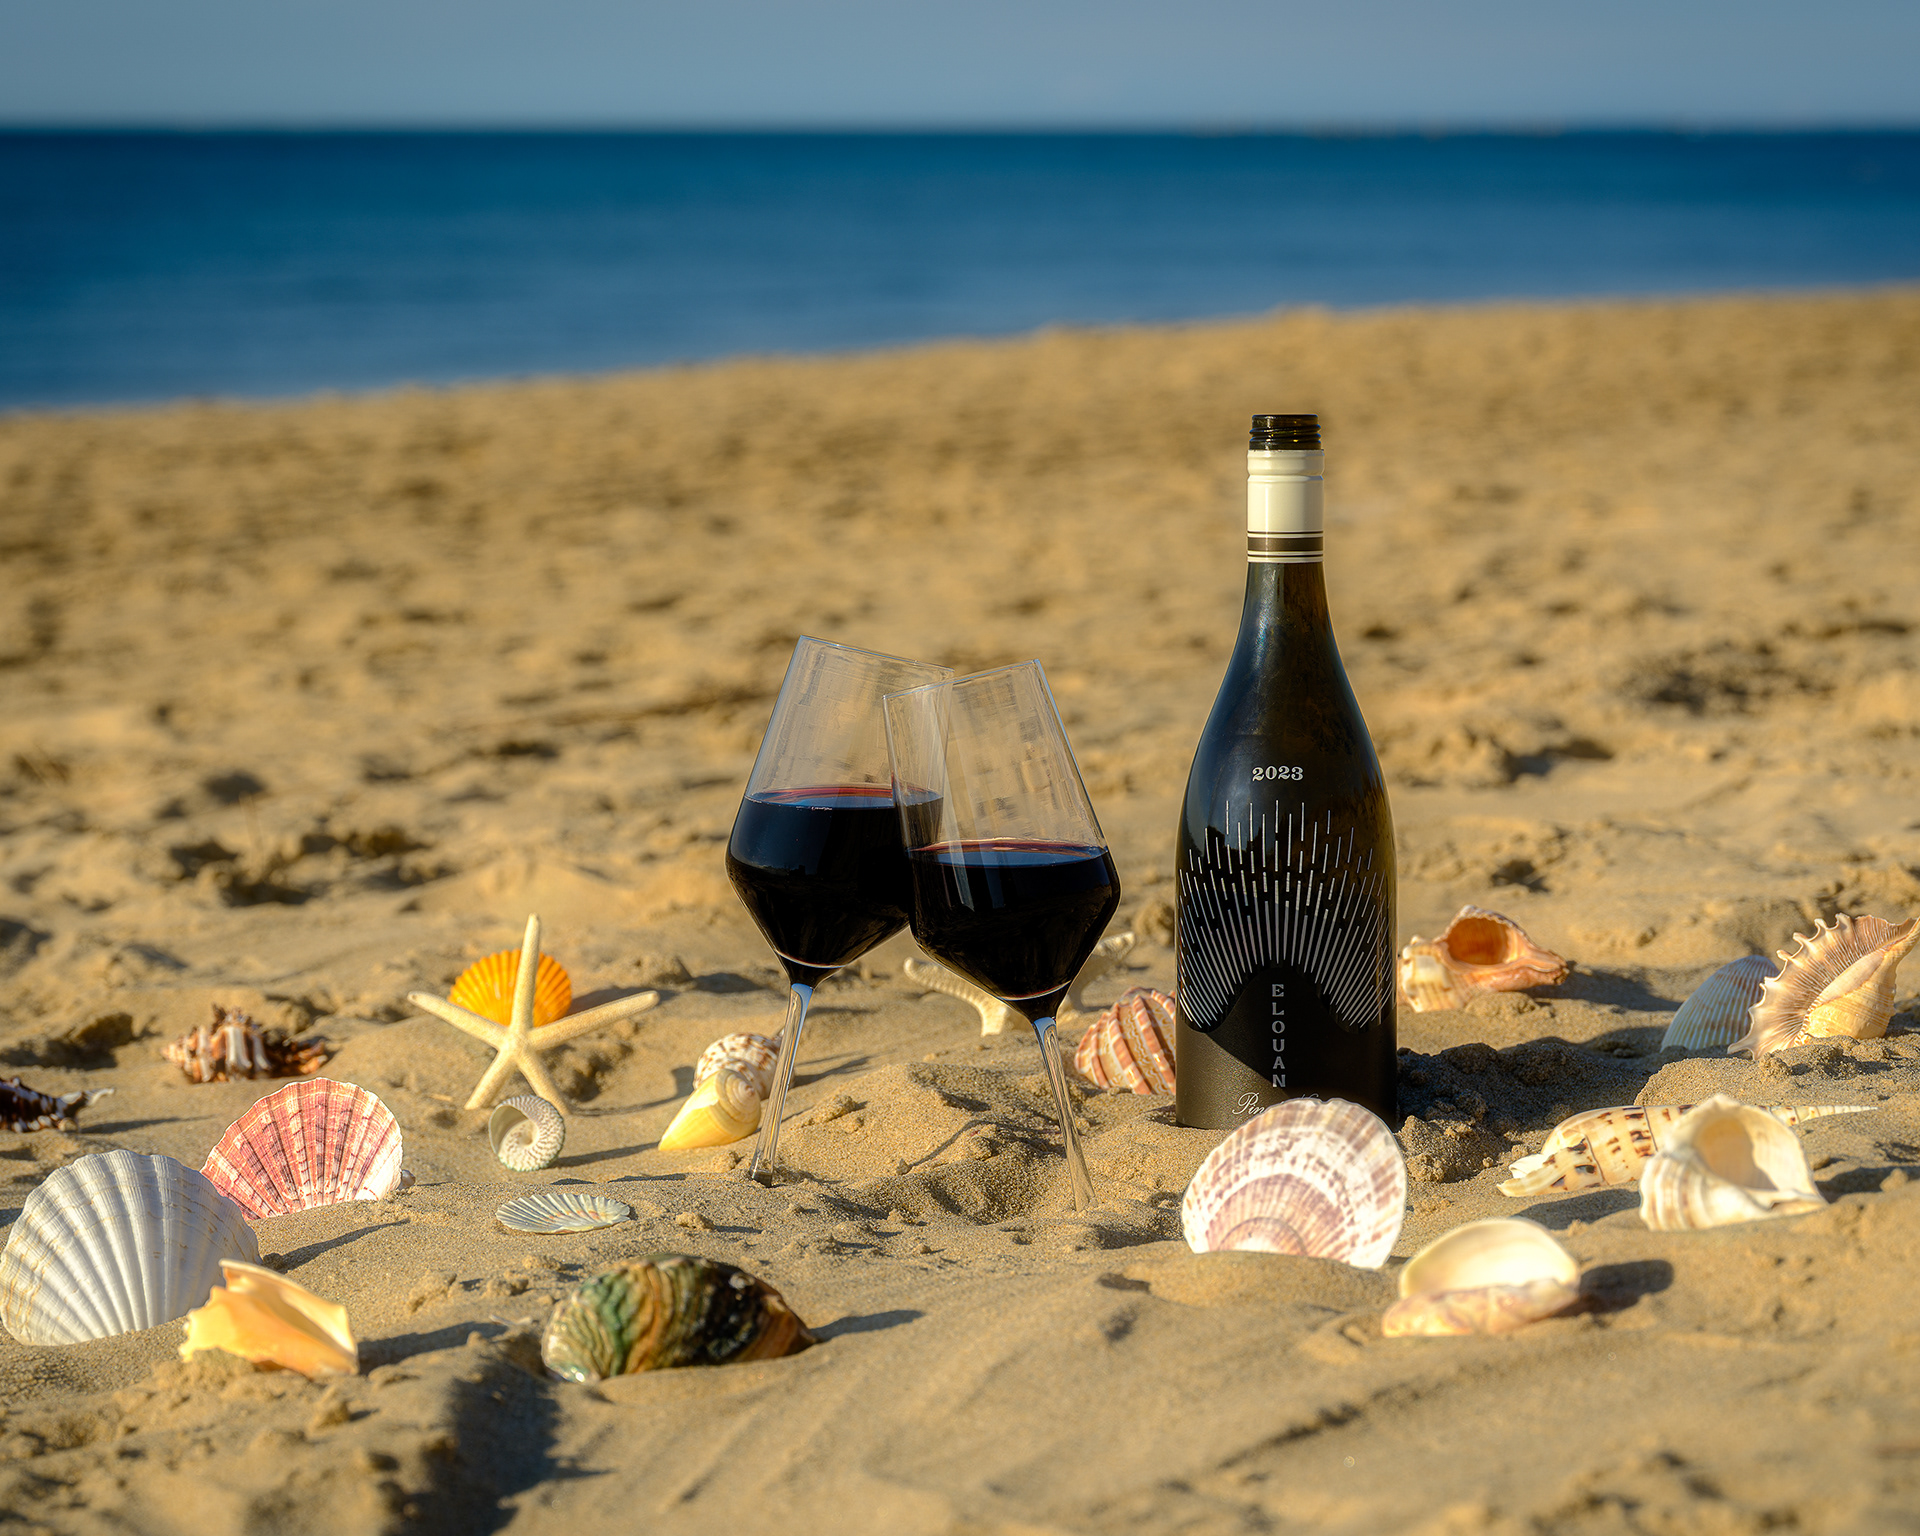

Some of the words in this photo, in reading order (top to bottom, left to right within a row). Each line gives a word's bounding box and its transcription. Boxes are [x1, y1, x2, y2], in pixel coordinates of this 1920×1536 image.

[1252, 765, 1304, 782] 2023
[1271, 983, 1286, 1088] ELOUAN
[1231, 1092, 1266, 1115] Pin
